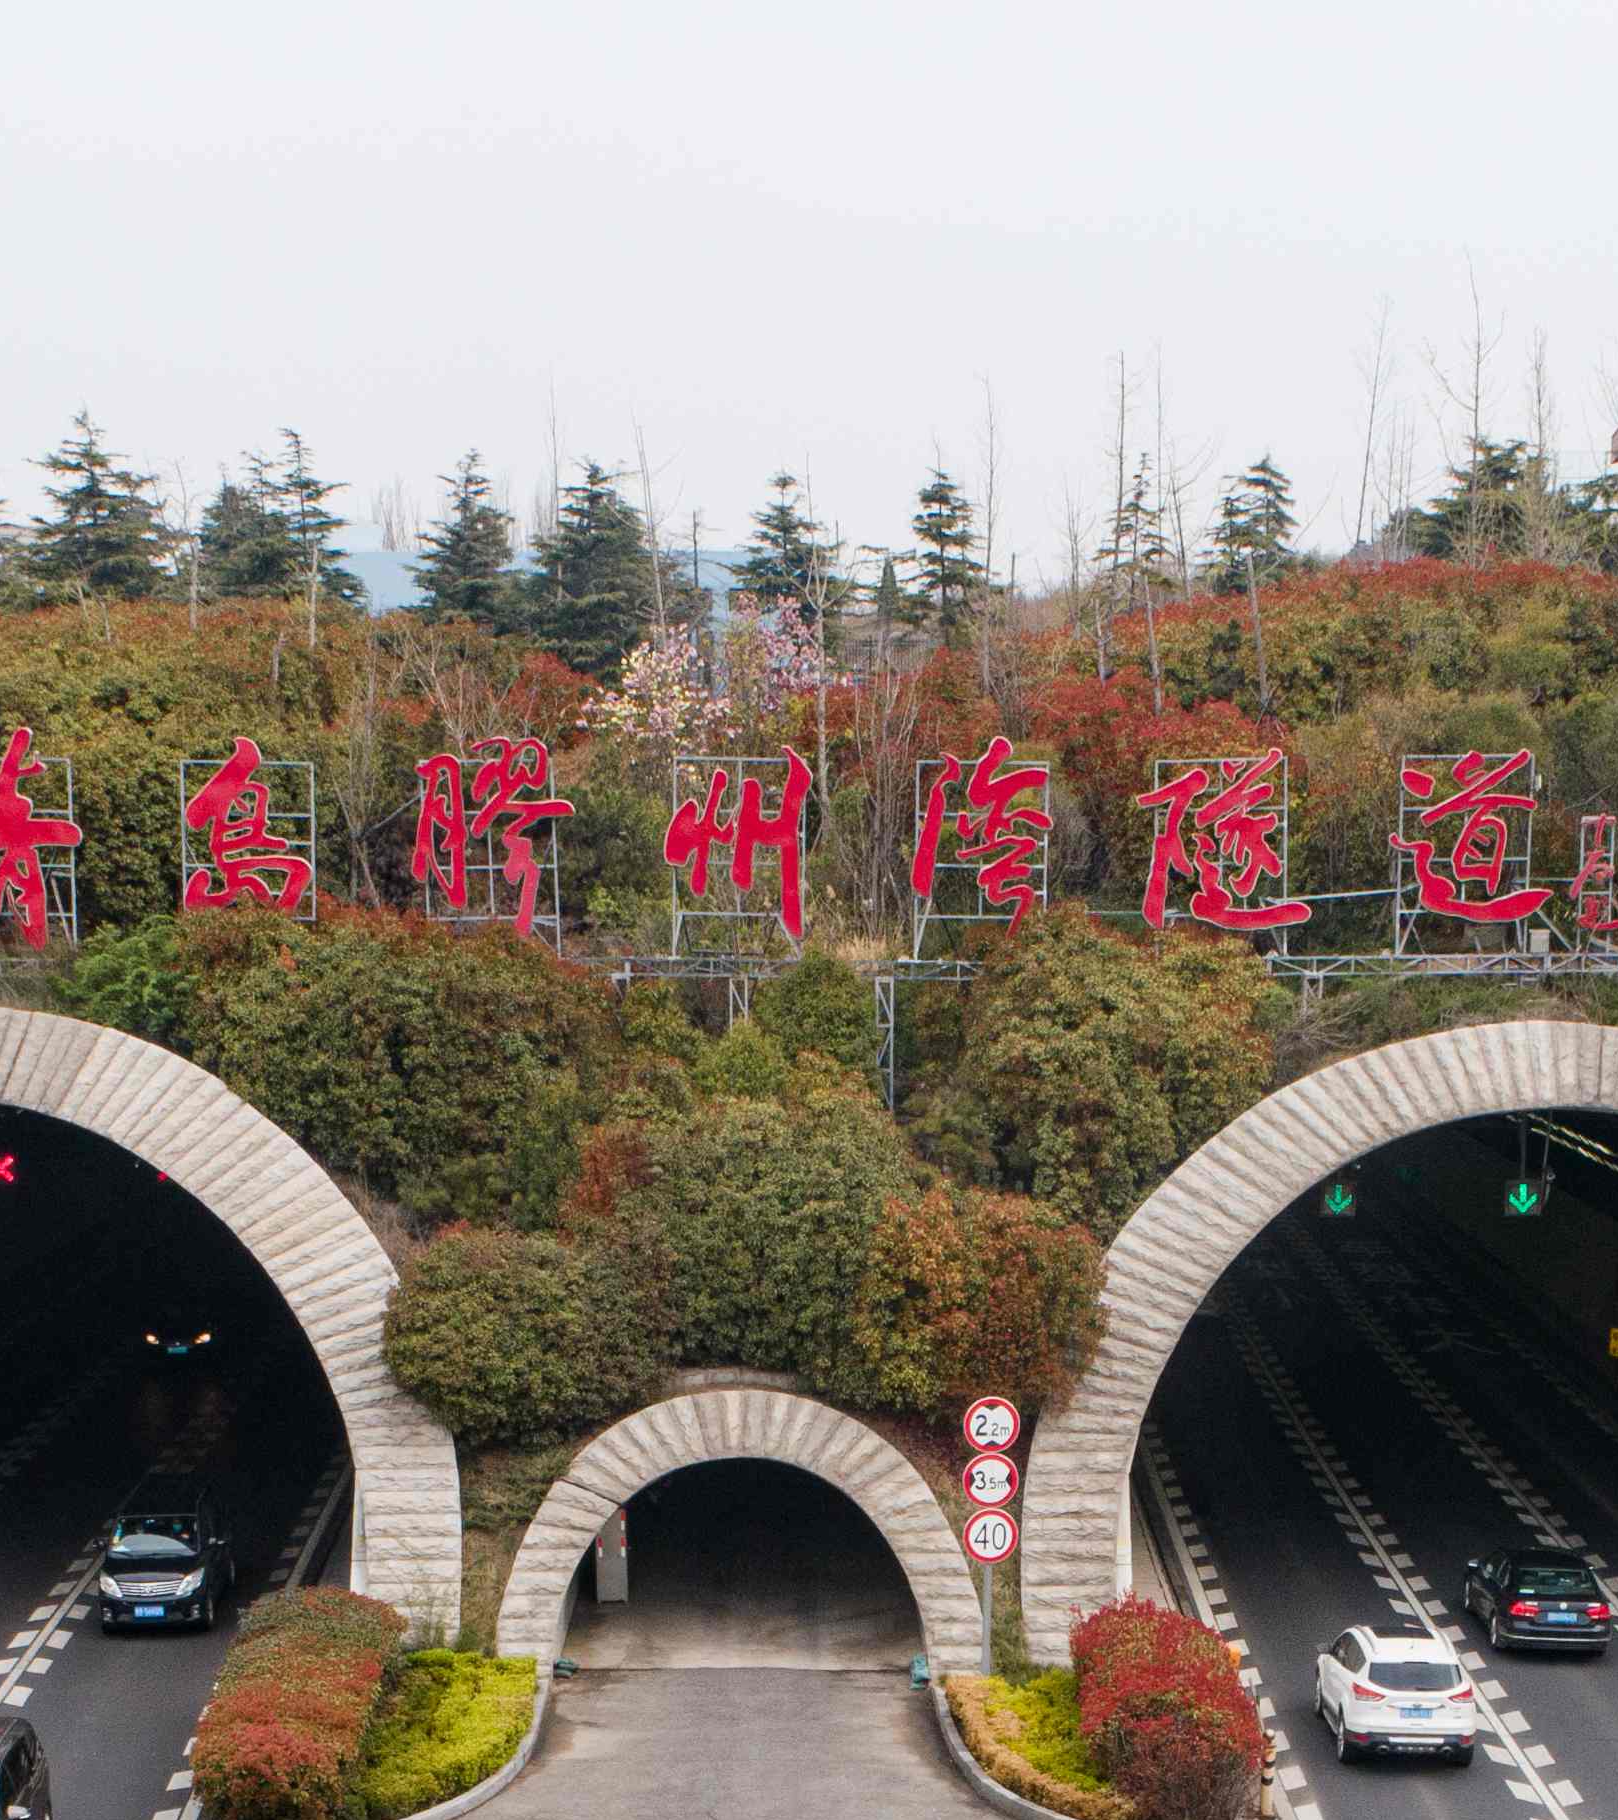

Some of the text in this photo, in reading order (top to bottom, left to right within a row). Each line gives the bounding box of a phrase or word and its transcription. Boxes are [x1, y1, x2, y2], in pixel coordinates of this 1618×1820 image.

[975, 1414, 1010, 1437] 2.2m
[975, 1471, 1007, 1490] 3.5m
[974, 1522, 1007, 1550] 40
